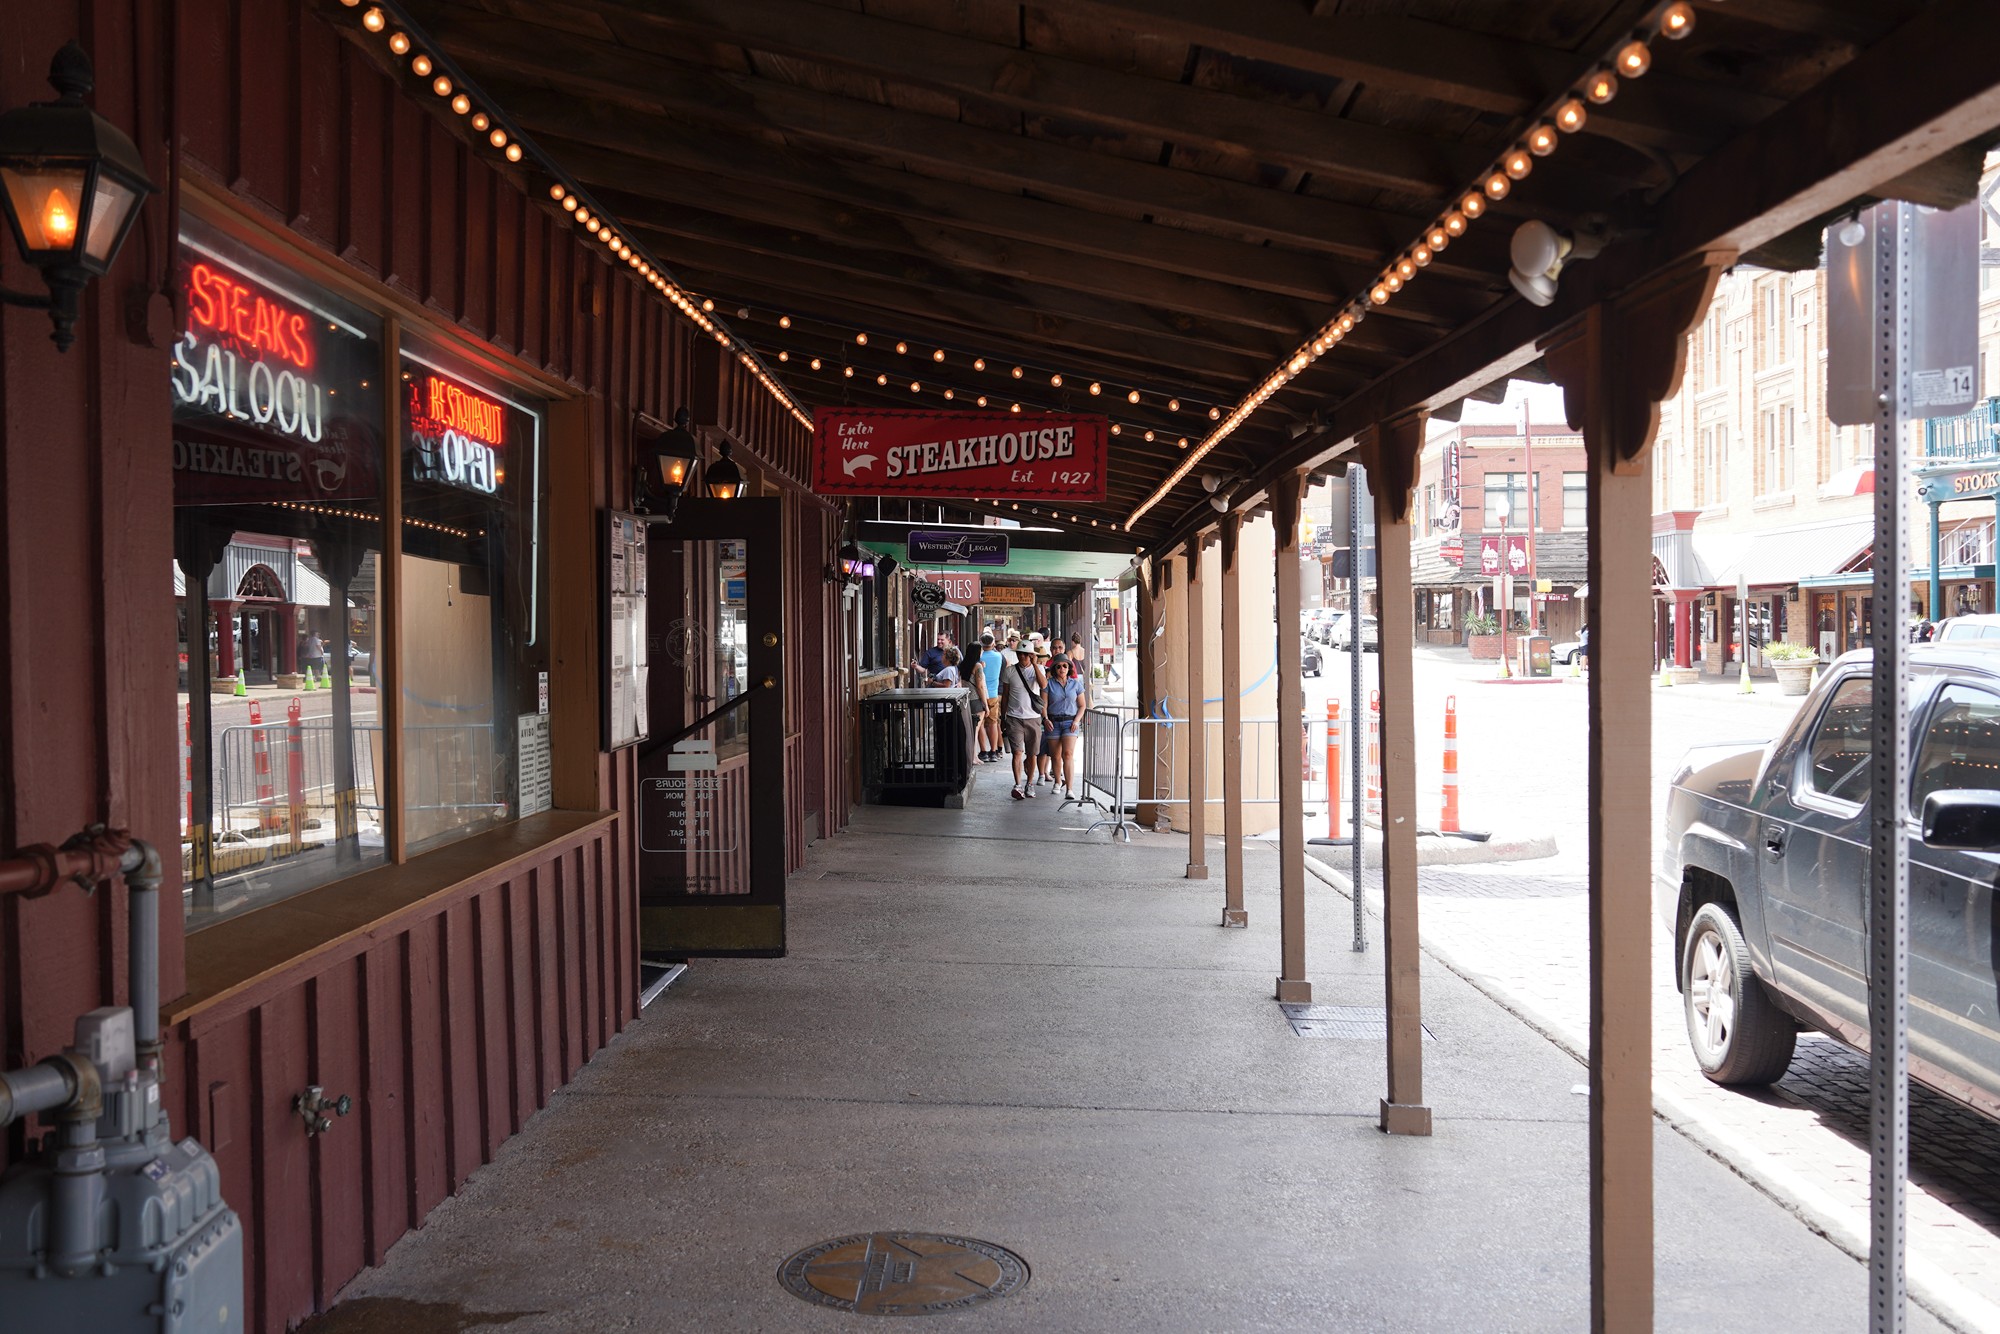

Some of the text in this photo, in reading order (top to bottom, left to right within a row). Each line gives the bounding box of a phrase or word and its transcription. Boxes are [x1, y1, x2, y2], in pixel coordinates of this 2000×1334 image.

[191, 263, 309, 368] STEAKS
[172, 331, 322, 443] SALOON
[1952, 376, 1970, 394] 14
[838, 421, 874, 438] Enter
[841, 437, 870, 451] Here
[886, 425, 1074, 478] STEAKHOUSE
[442, 429, 497, 494] OPEN
[1011, 470, 1091, 485] Est. 1927
[1954, 471, 2000, 493] STOCK
[969, 543, 998, 552] LEGACY
[915, 582, 944, 595] COWBOY
[984, 587, 1003, 597] CHILI
